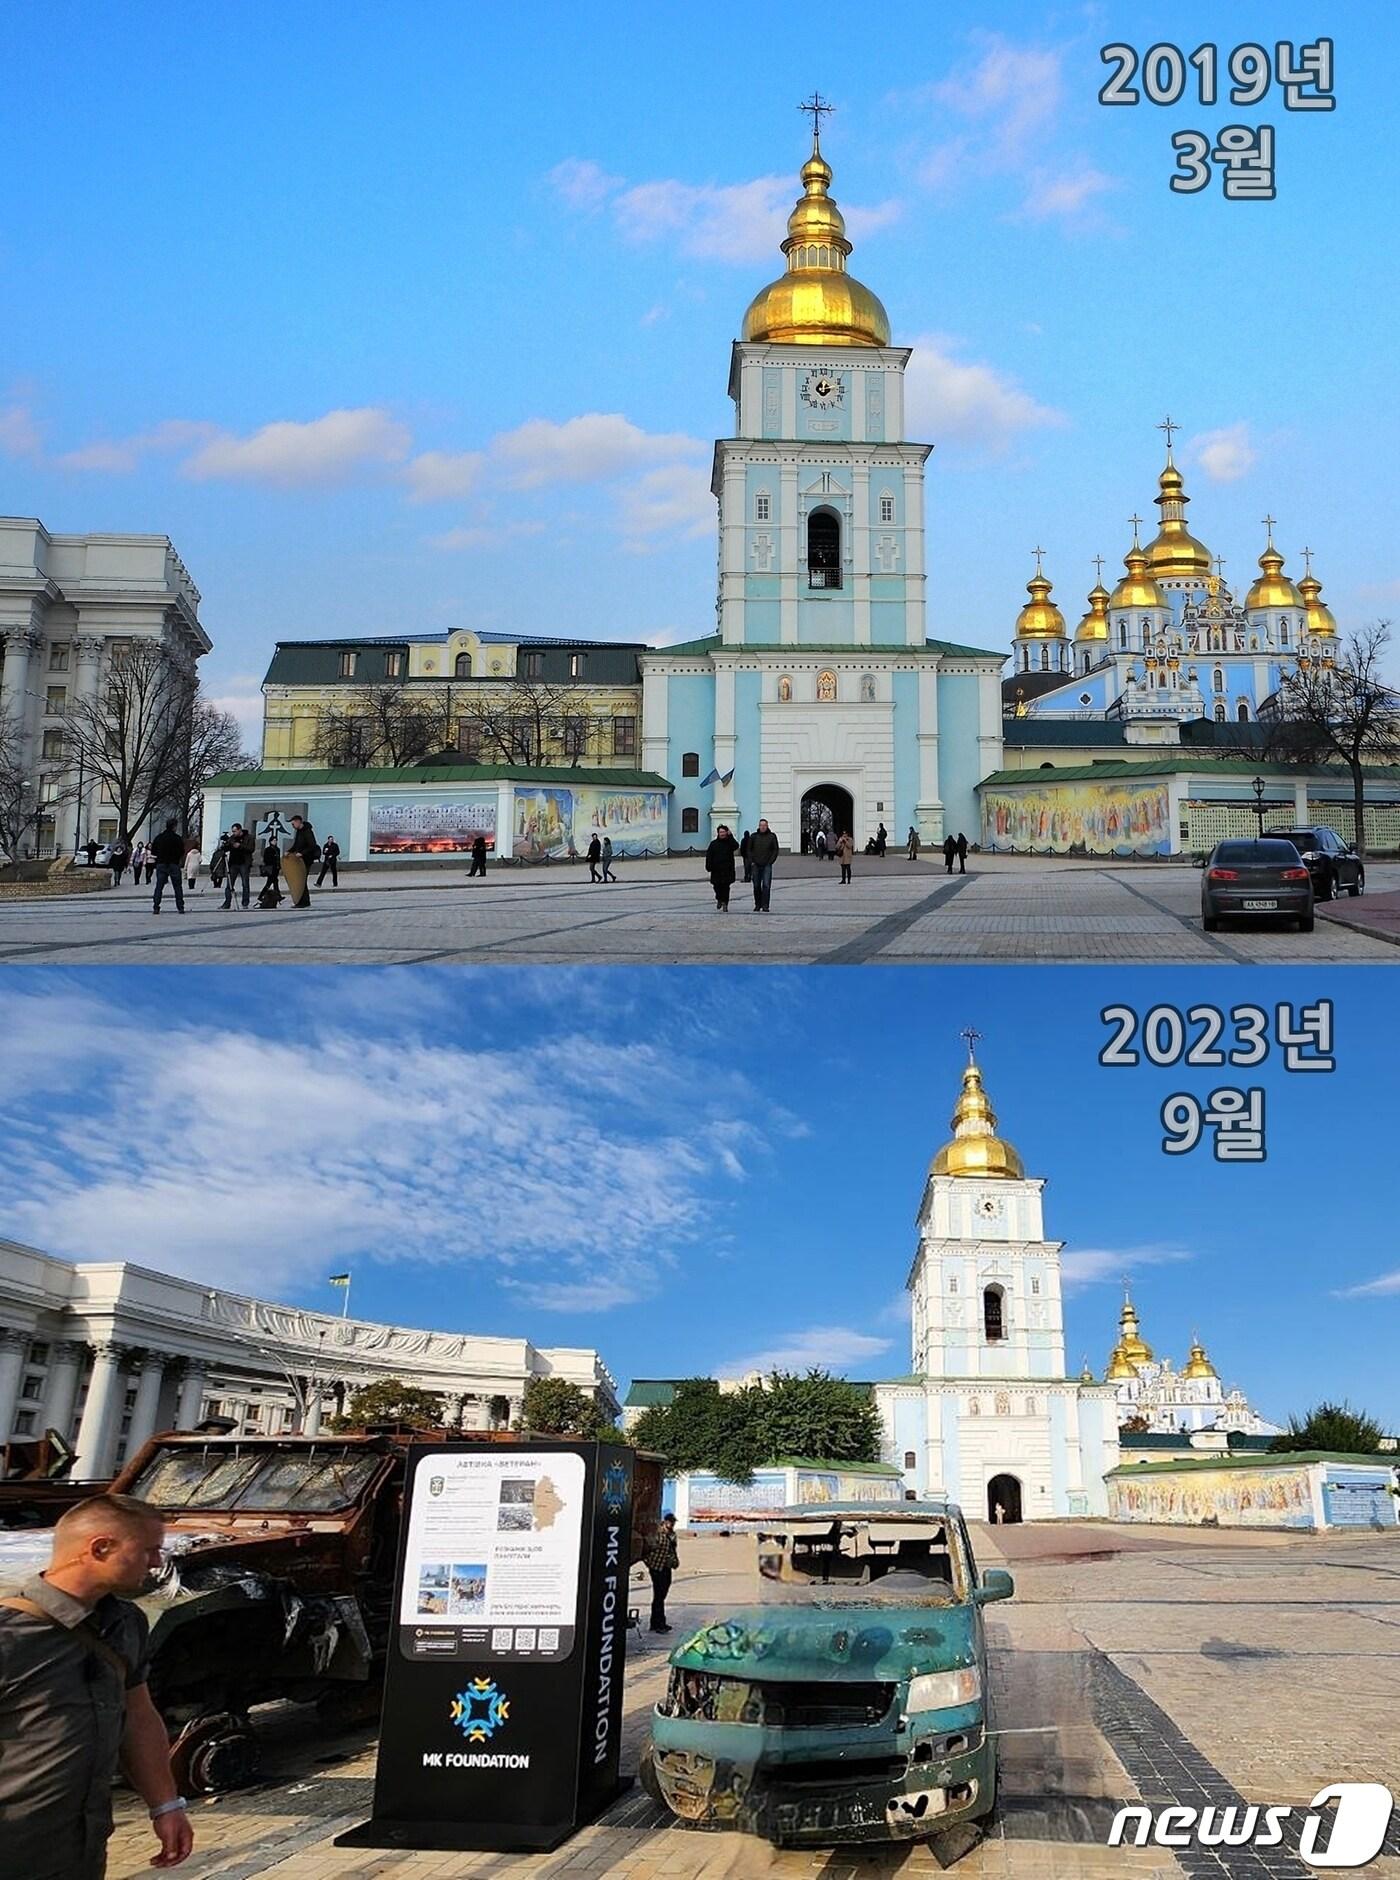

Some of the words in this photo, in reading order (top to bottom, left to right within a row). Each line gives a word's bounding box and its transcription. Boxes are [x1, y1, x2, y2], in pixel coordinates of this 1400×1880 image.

[605, 1526, 619, 1567] MK
[594, 1575, 616, 1764] FOUNDATION
[423, 1753, 443, 1767] MK
[445, 1753, 530, 1769] FOUNDATION
